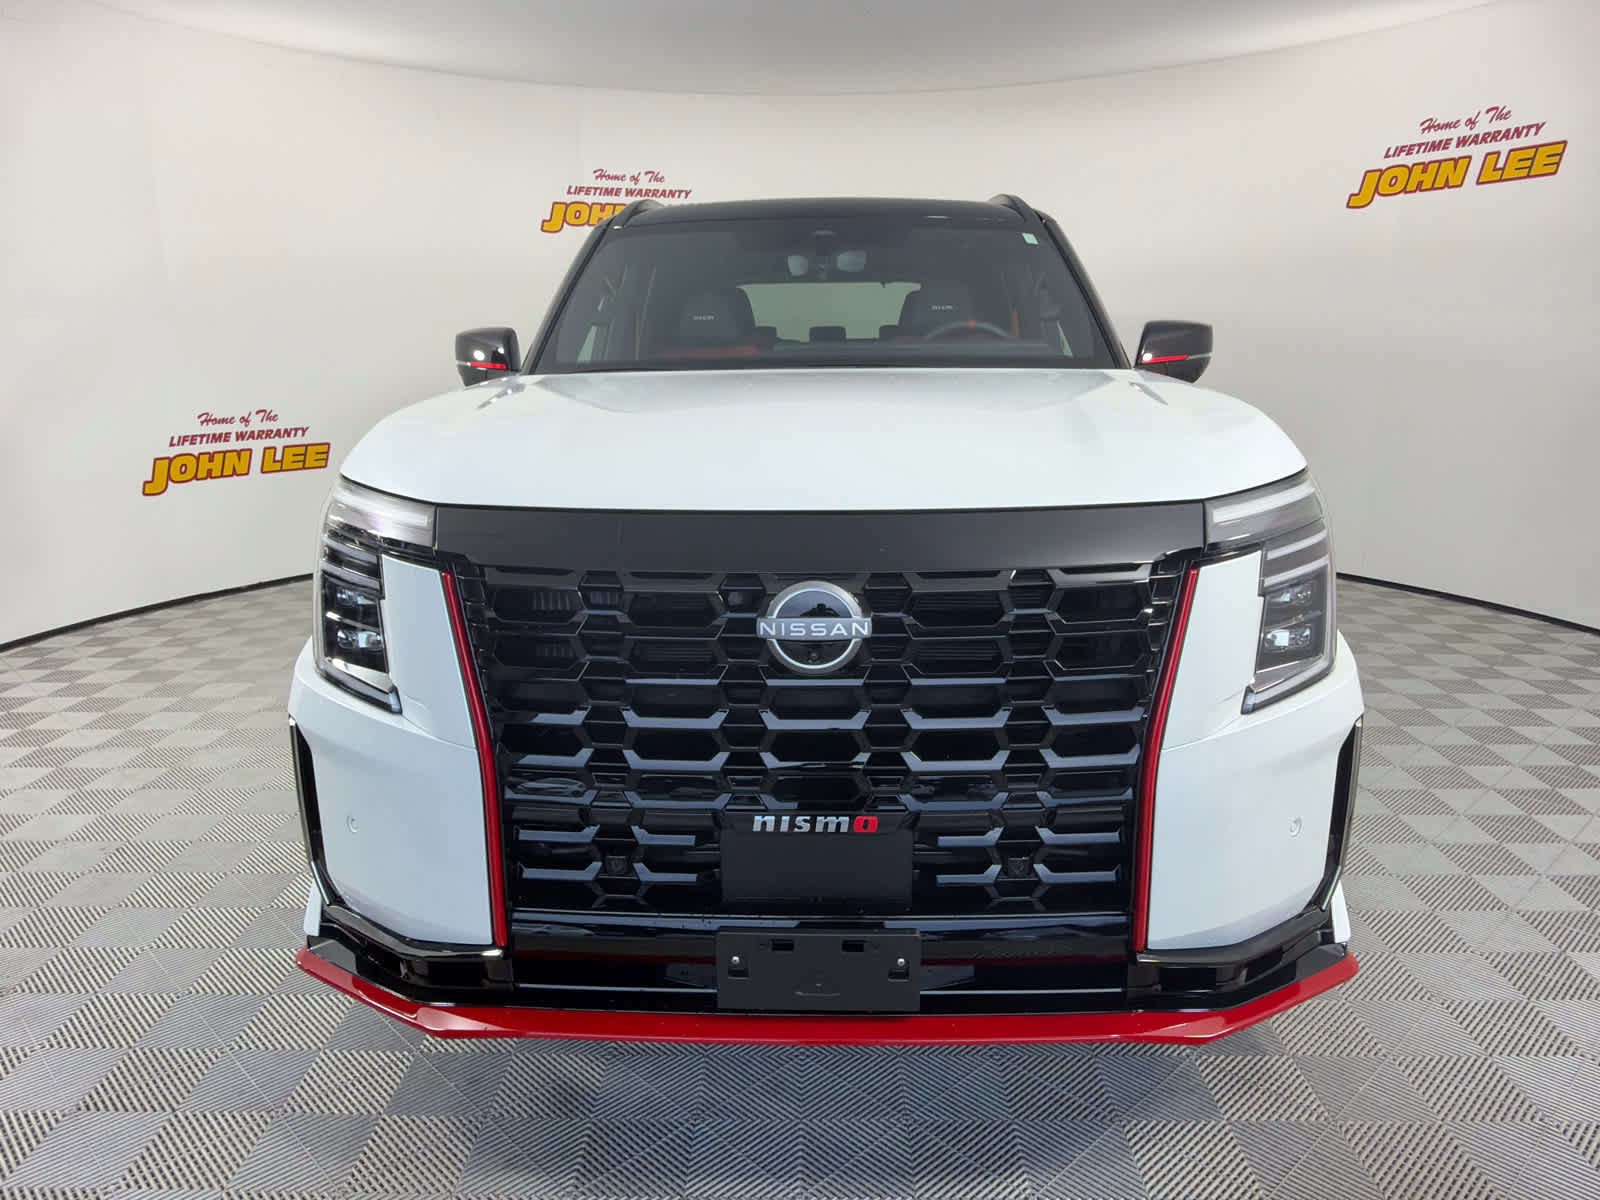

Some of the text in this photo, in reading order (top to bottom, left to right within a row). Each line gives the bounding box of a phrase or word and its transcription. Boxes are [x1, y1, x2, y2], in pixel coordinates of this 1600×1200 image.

[1419, 105, 1511, 135] Home of The
[1383, 121, 1546, 159] LIFETIME WARRANTY
[593, 168, 665, 185] Home of The
[1346, 140, 1568, 208] JOHN LEE
[567, 185, 692, 199] LIFETIME WARRANTY
[541, 201, 629, 233] JOH
[197, 408, 279, 428] Home of The
[168, 426, 310, 447] LIFETIME WARRANTY
[142, 442, 331, 496] JOHN LEE
[760, 621, 869, 637] NISSAN
[752, 815, 878, 833] nismo
